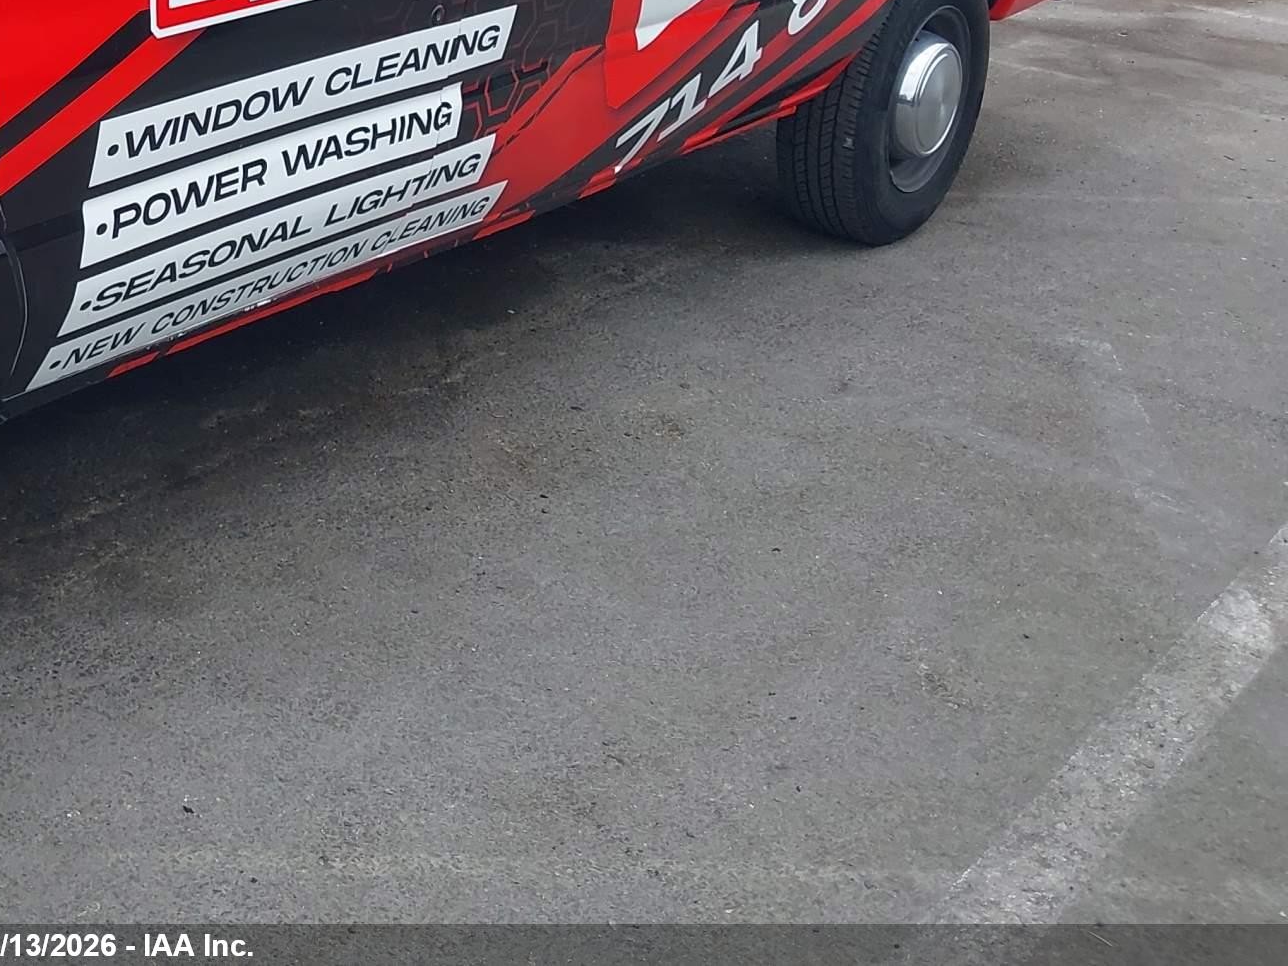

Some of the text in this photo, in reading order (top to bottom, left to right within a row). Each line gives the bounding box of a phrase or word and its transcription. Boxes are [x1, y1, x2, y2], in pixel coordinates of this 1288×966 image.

[126, 24, 501, 159] WINDOW CLEANING
[614, 19, 763, 174] 714
[92, 153, 481, 312] SEASONAL LIGHTING
[112, 101, 453, 239] POWER WASHING
[61, 195, 491, 370] NEW CONSTRUCTION CLEANING
